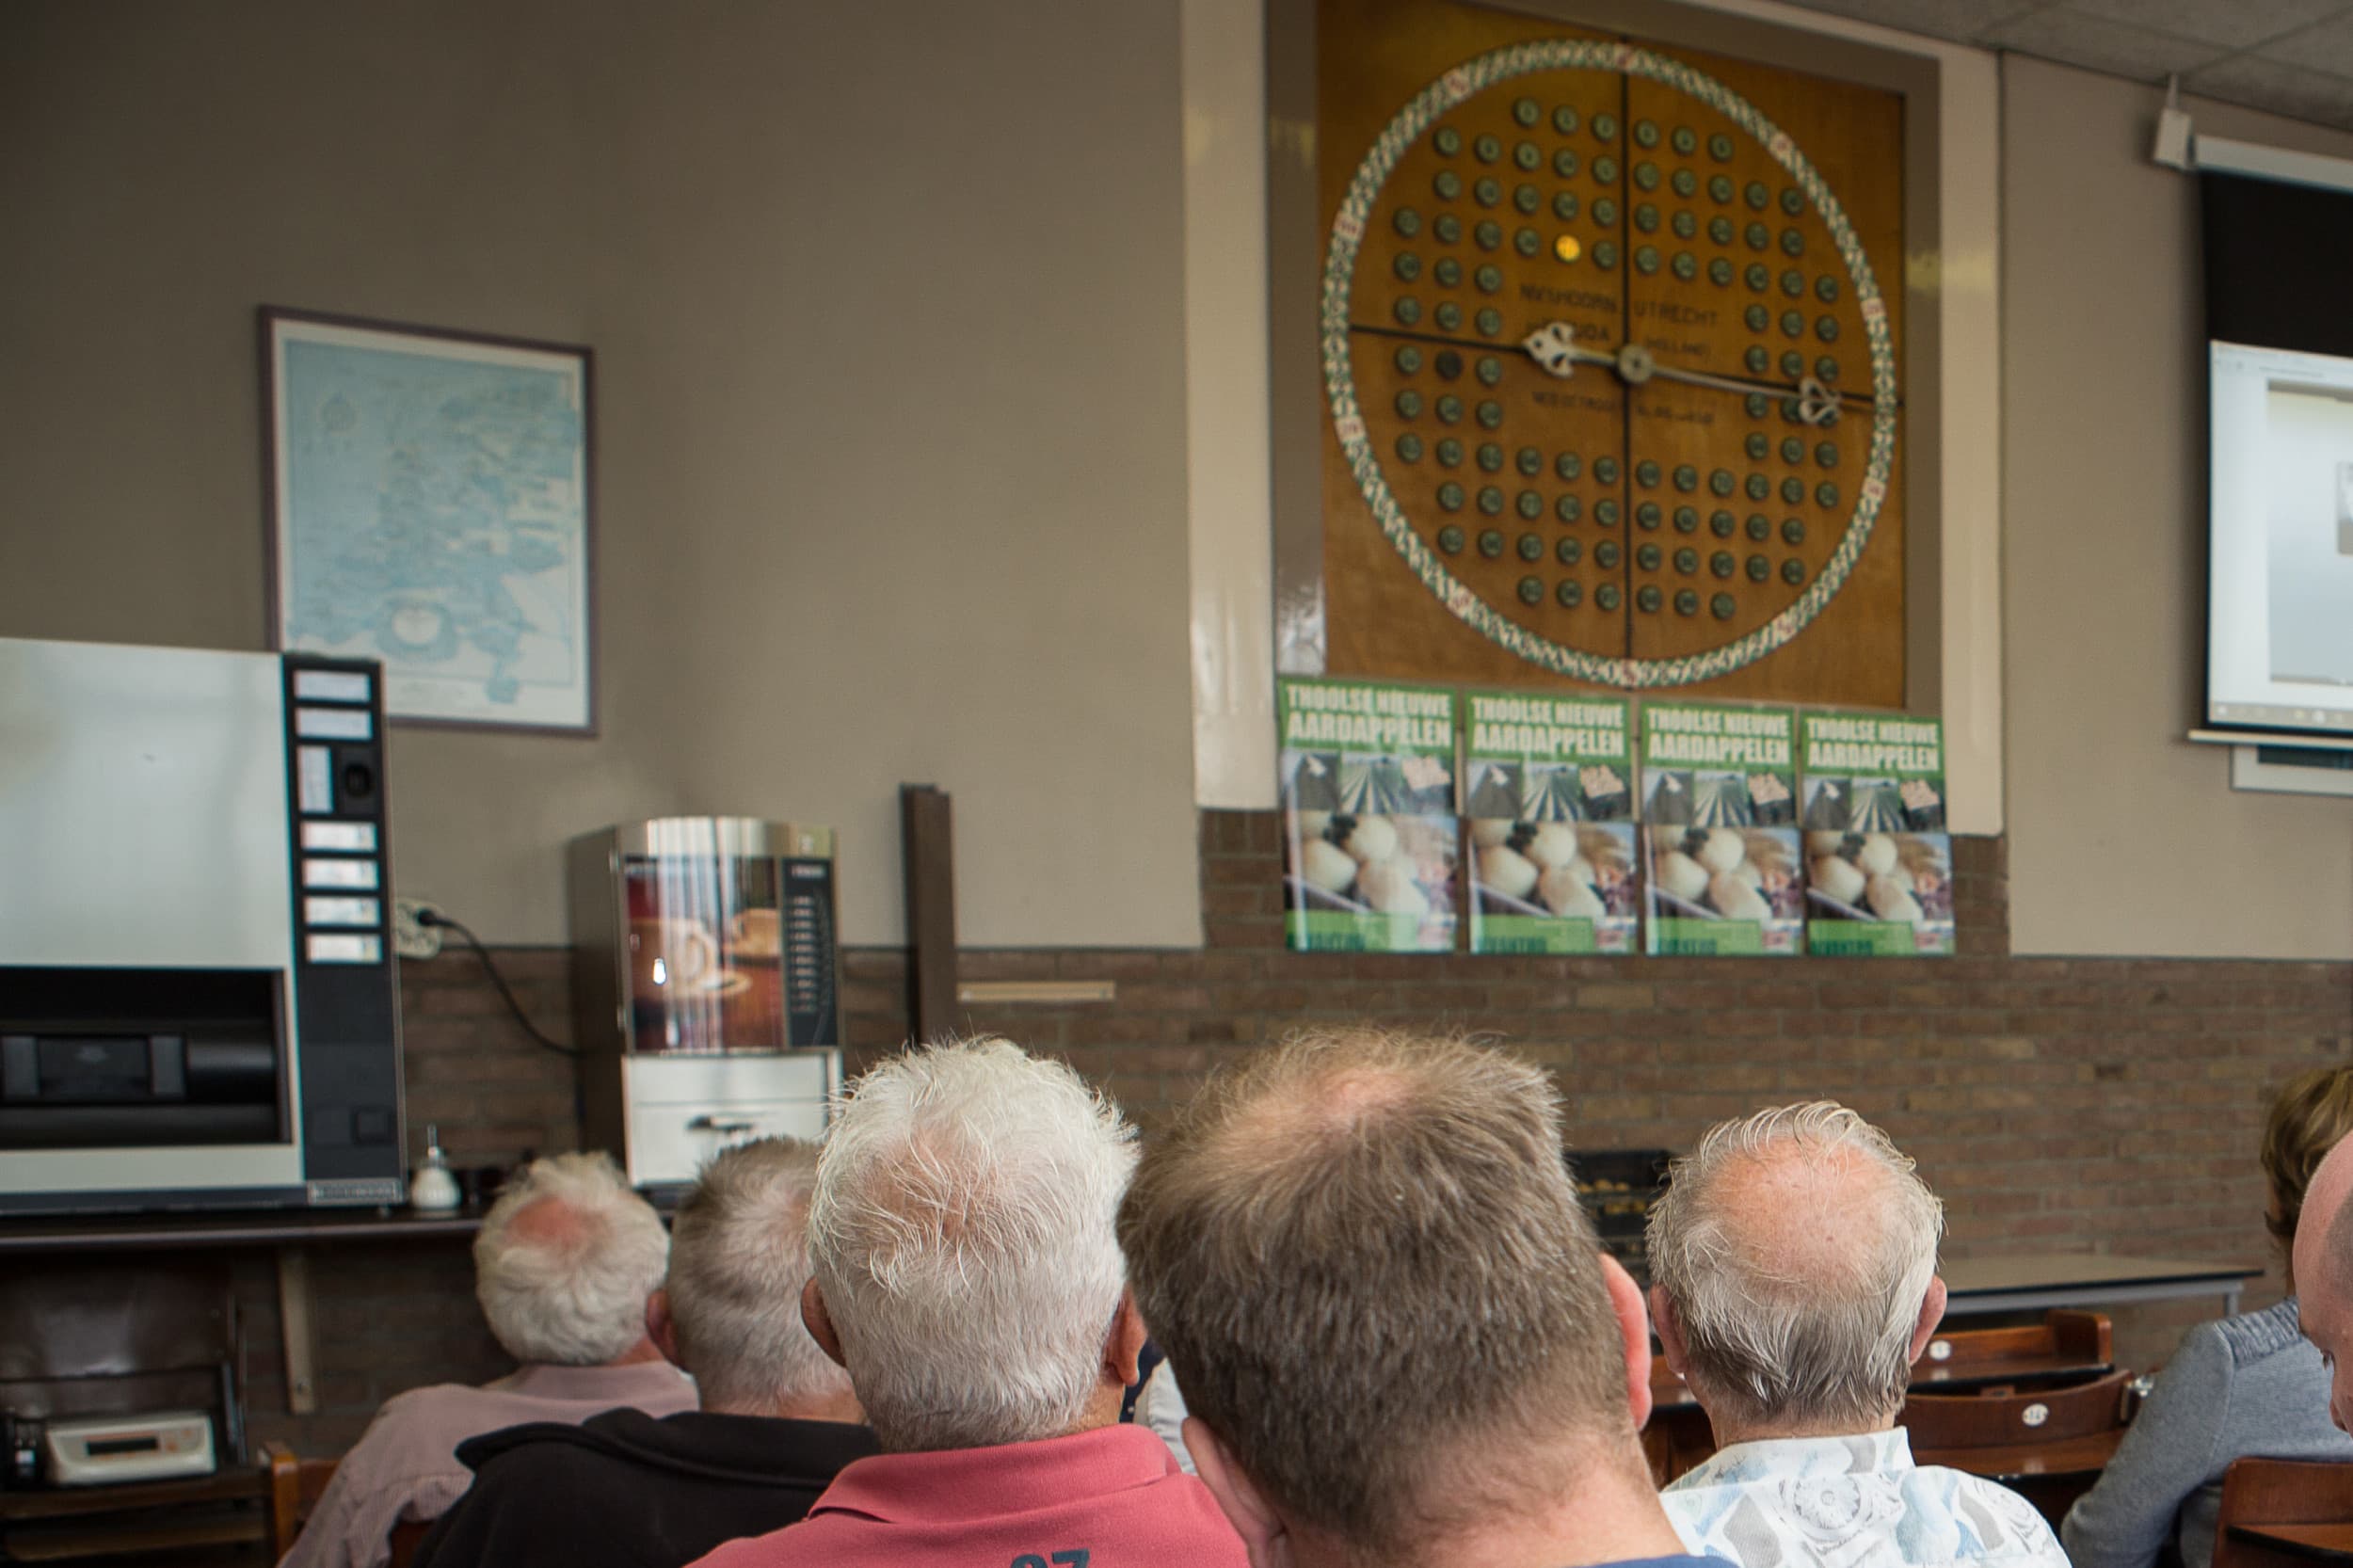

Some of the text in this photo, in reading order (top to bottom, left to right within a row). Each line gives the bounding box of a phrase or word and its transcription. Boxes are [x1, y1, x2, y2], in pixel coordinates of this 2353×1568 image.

[1287, 684, 1450, 717] THOOLSE NIEUWE
[1471, 696, 1625, 728] THOOLSE NIEUWE
[1288, 711, 1451, 746] AARDAPPELEN
[1647, 707, 1787, 737] THOOLSE NIEUWE
[1806, 717, 1939, 744] THOOLSE NIEUWE
[1473, 722, 1625, 757] AARDAPPELEN
[1649, 732, 1788, 764] AARDAPPELEN
[1808, 741, 1940, 771] AARDAPPELEN
